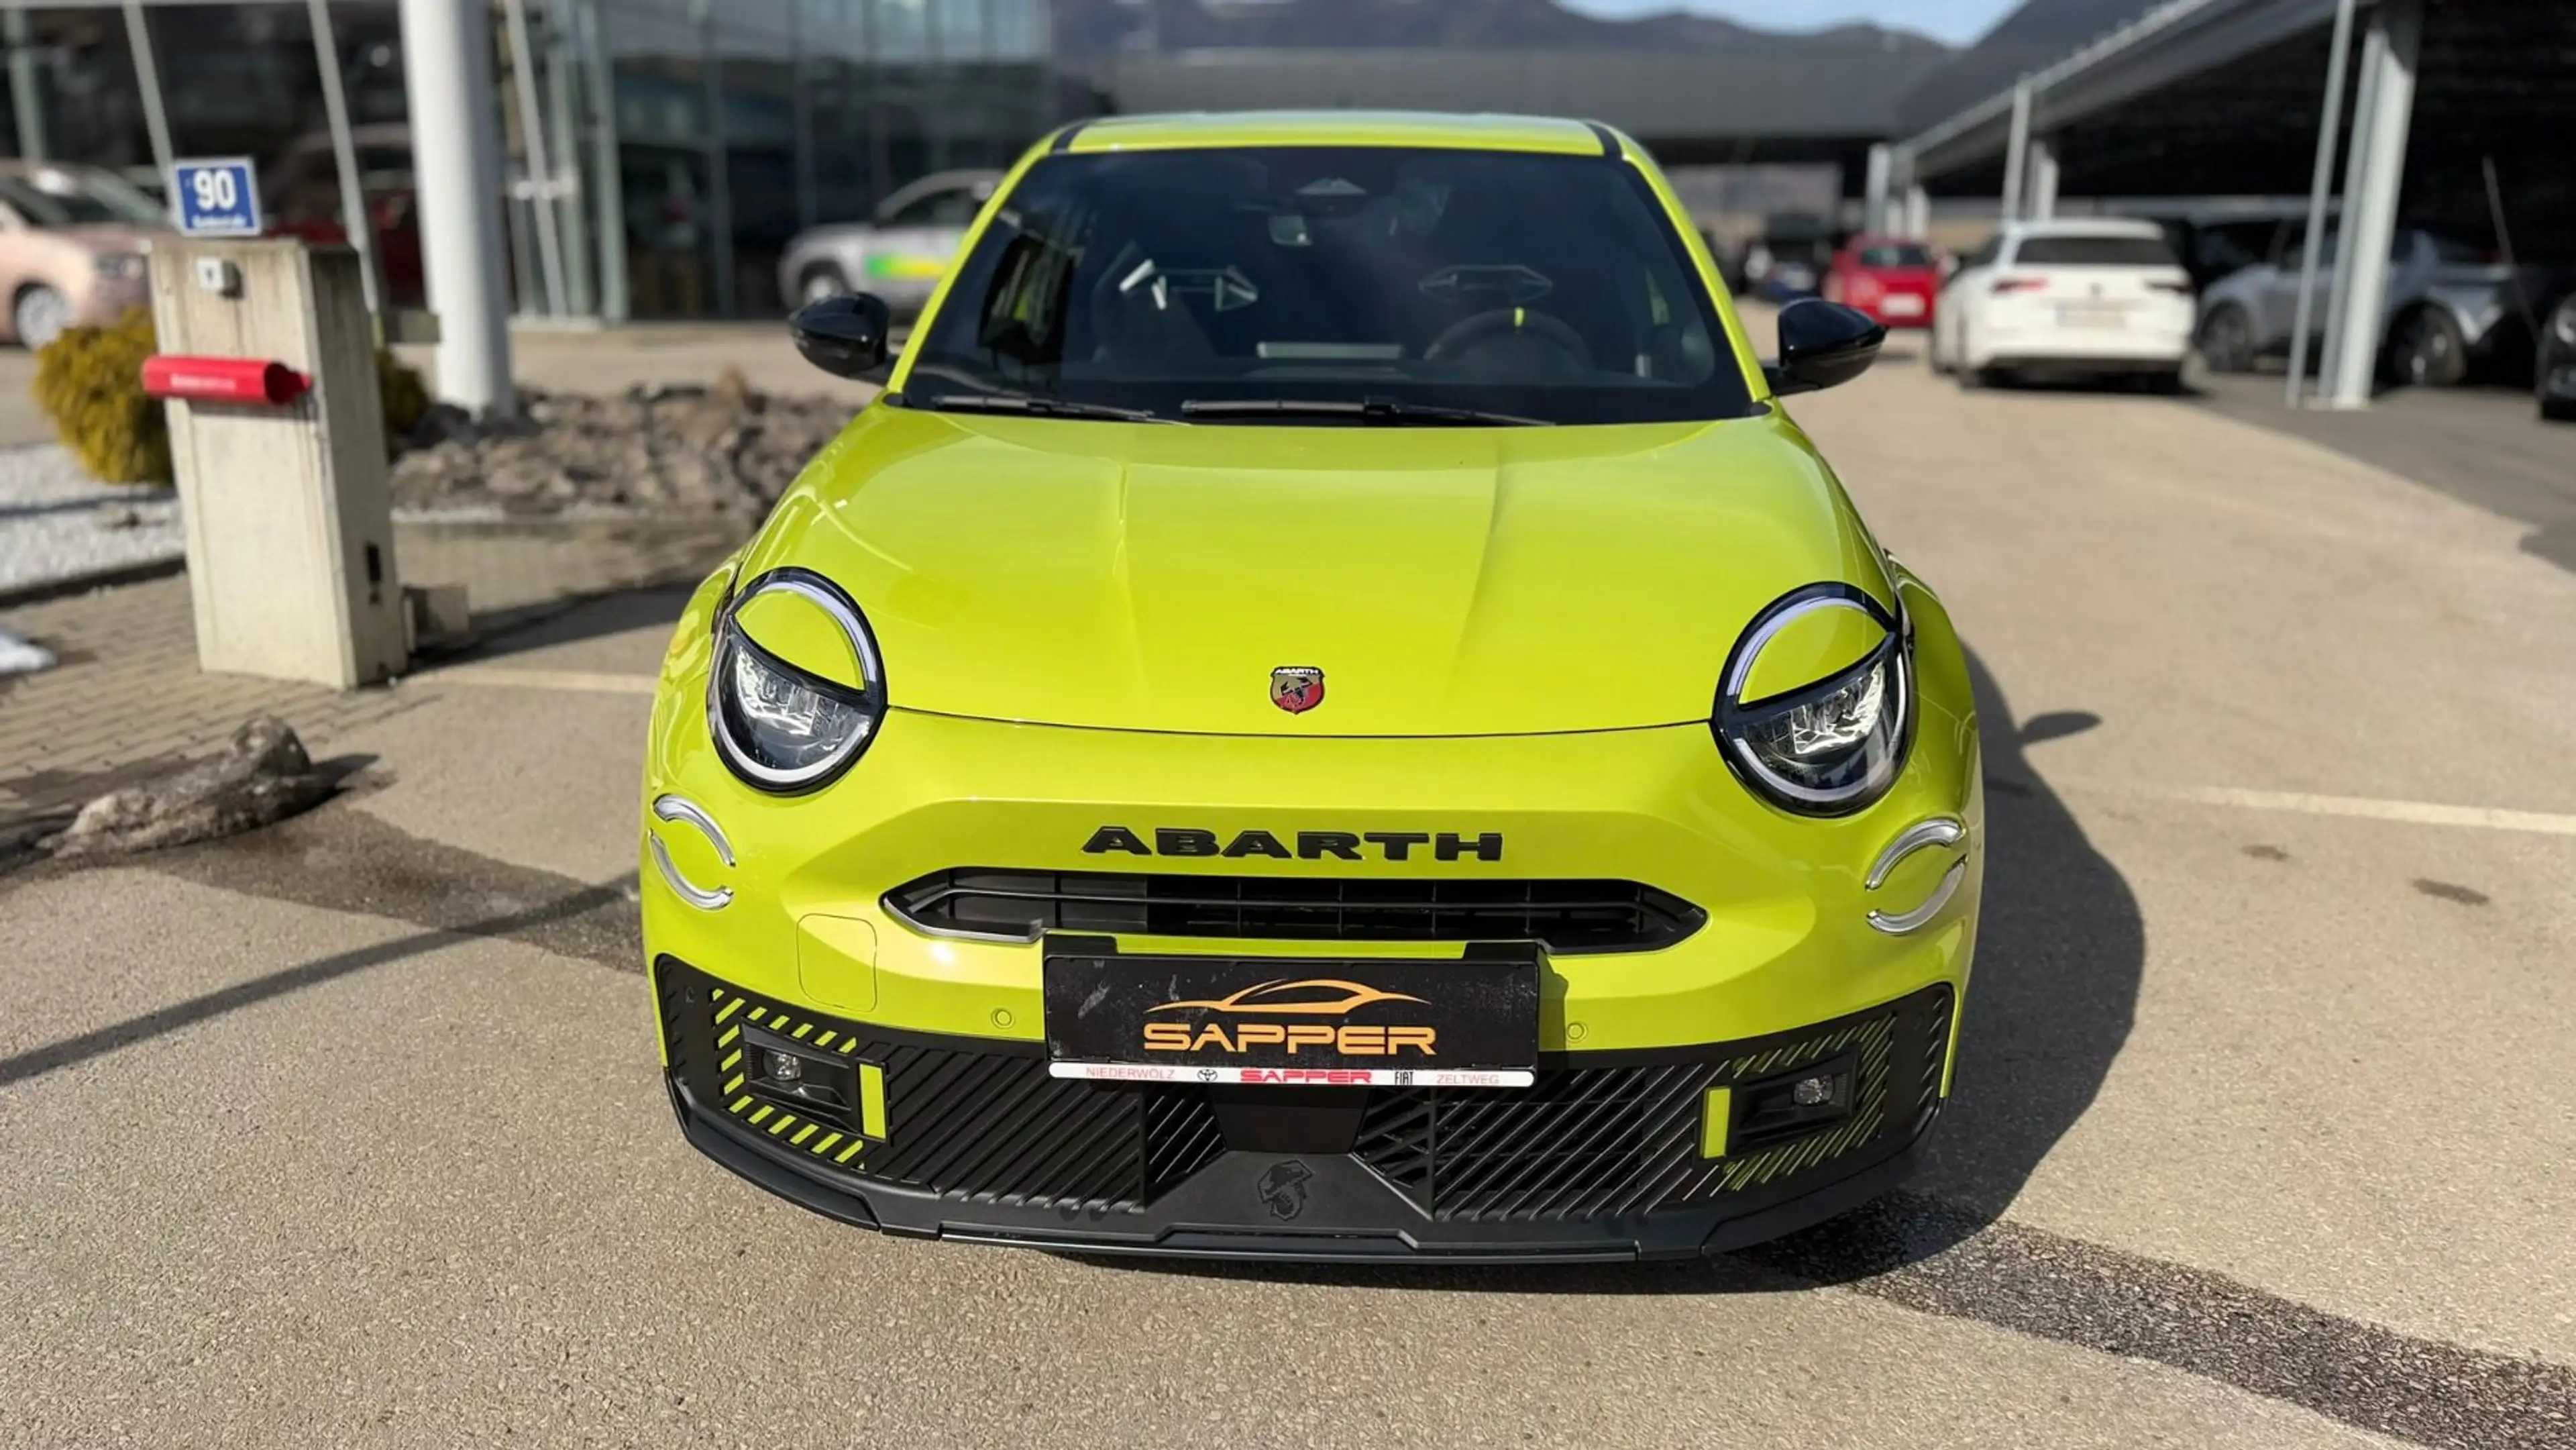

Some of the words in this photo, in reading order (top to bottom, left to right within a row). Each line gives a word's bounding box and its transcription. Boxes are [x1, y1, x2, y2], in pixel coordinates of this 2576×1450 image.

[194, 169, 237, 210] 90
[1081, 826, 1503, 861] ABARTH
[1143, 1023, 1437, 1055] SAPPER
[1240, 1069, 1371, 1084] SAPPER
[1395, 1071, 1415, 1085] FIAT
[1437, 1074, 1500, 1084] ZELTWEG
